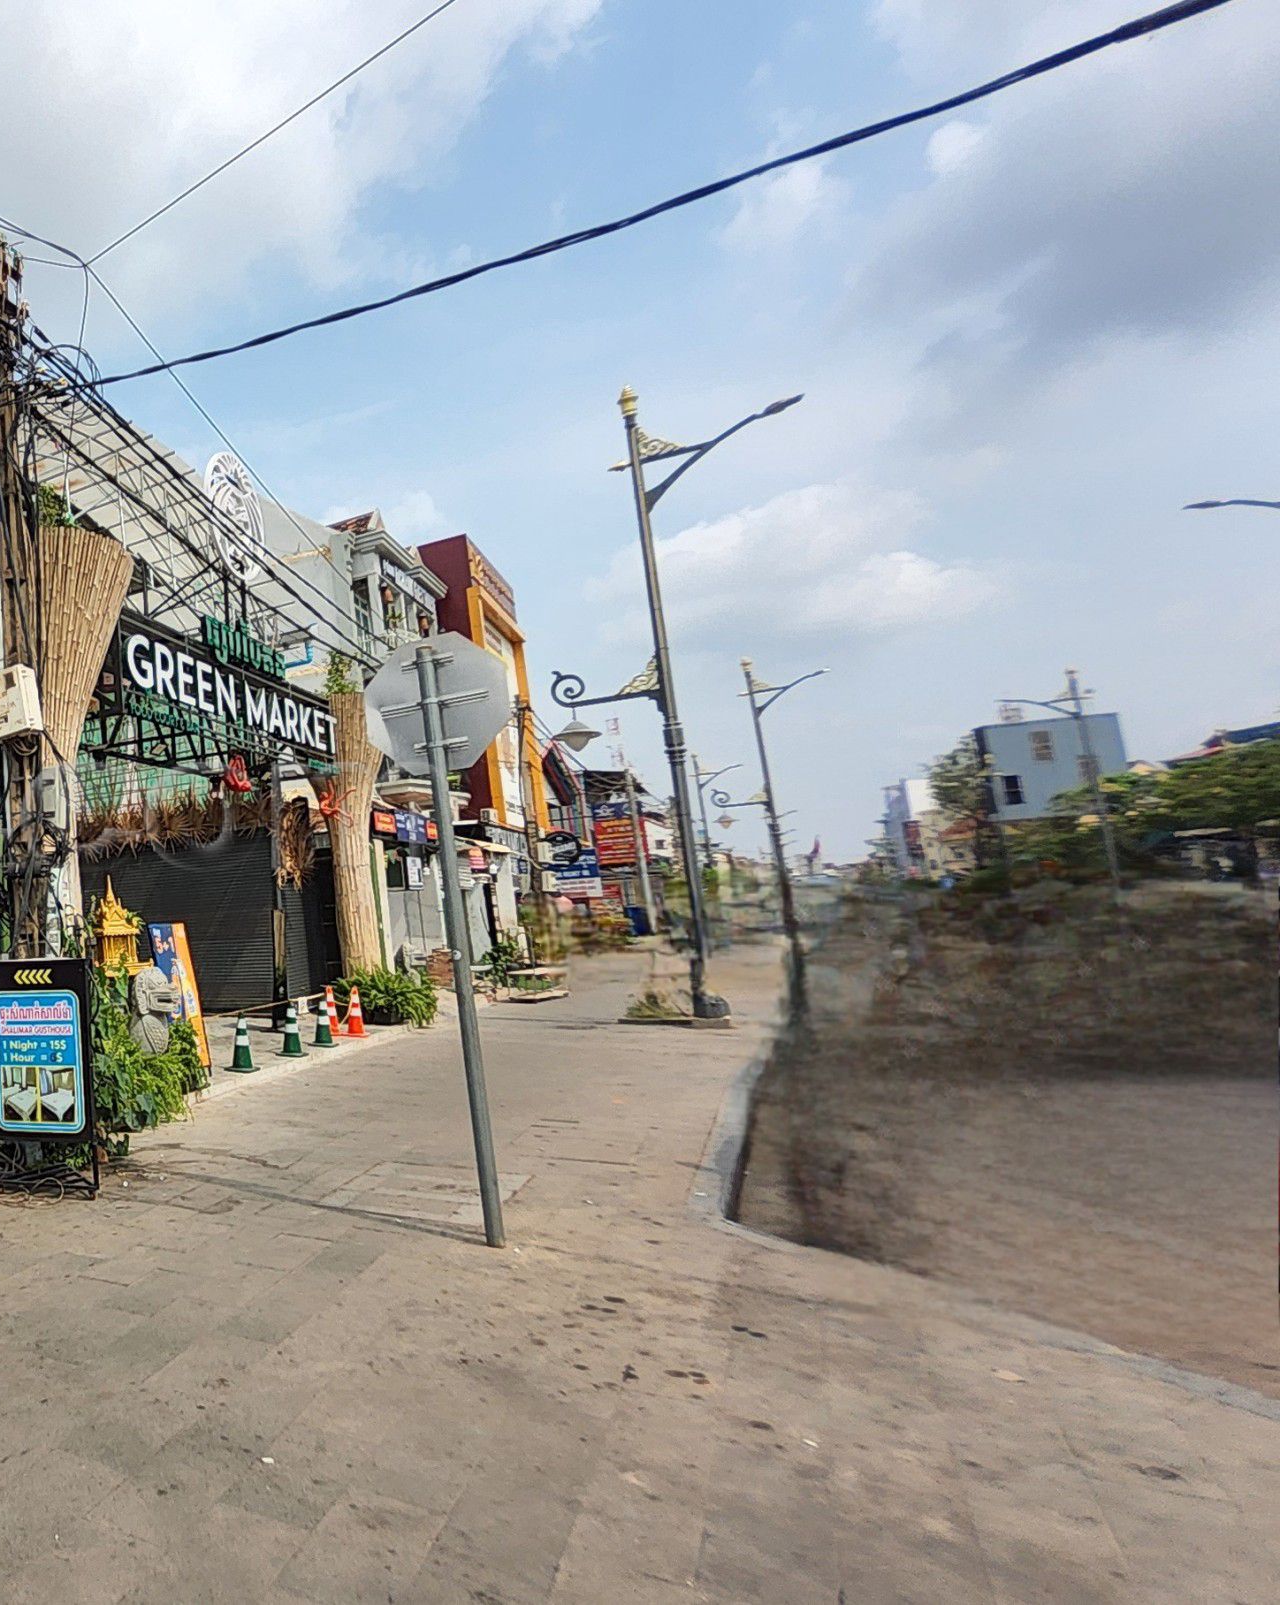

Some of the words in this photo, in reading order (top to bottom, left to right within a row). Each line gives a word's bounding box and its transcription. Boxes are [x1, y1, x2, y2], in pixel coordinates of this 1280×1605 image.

[126, 634, 237, 720] GREEN
[244, 680, 337, 755] MARKET
[9, 1040, 38, 1052] Night
[10, 1053, 35, 1062] Hour
